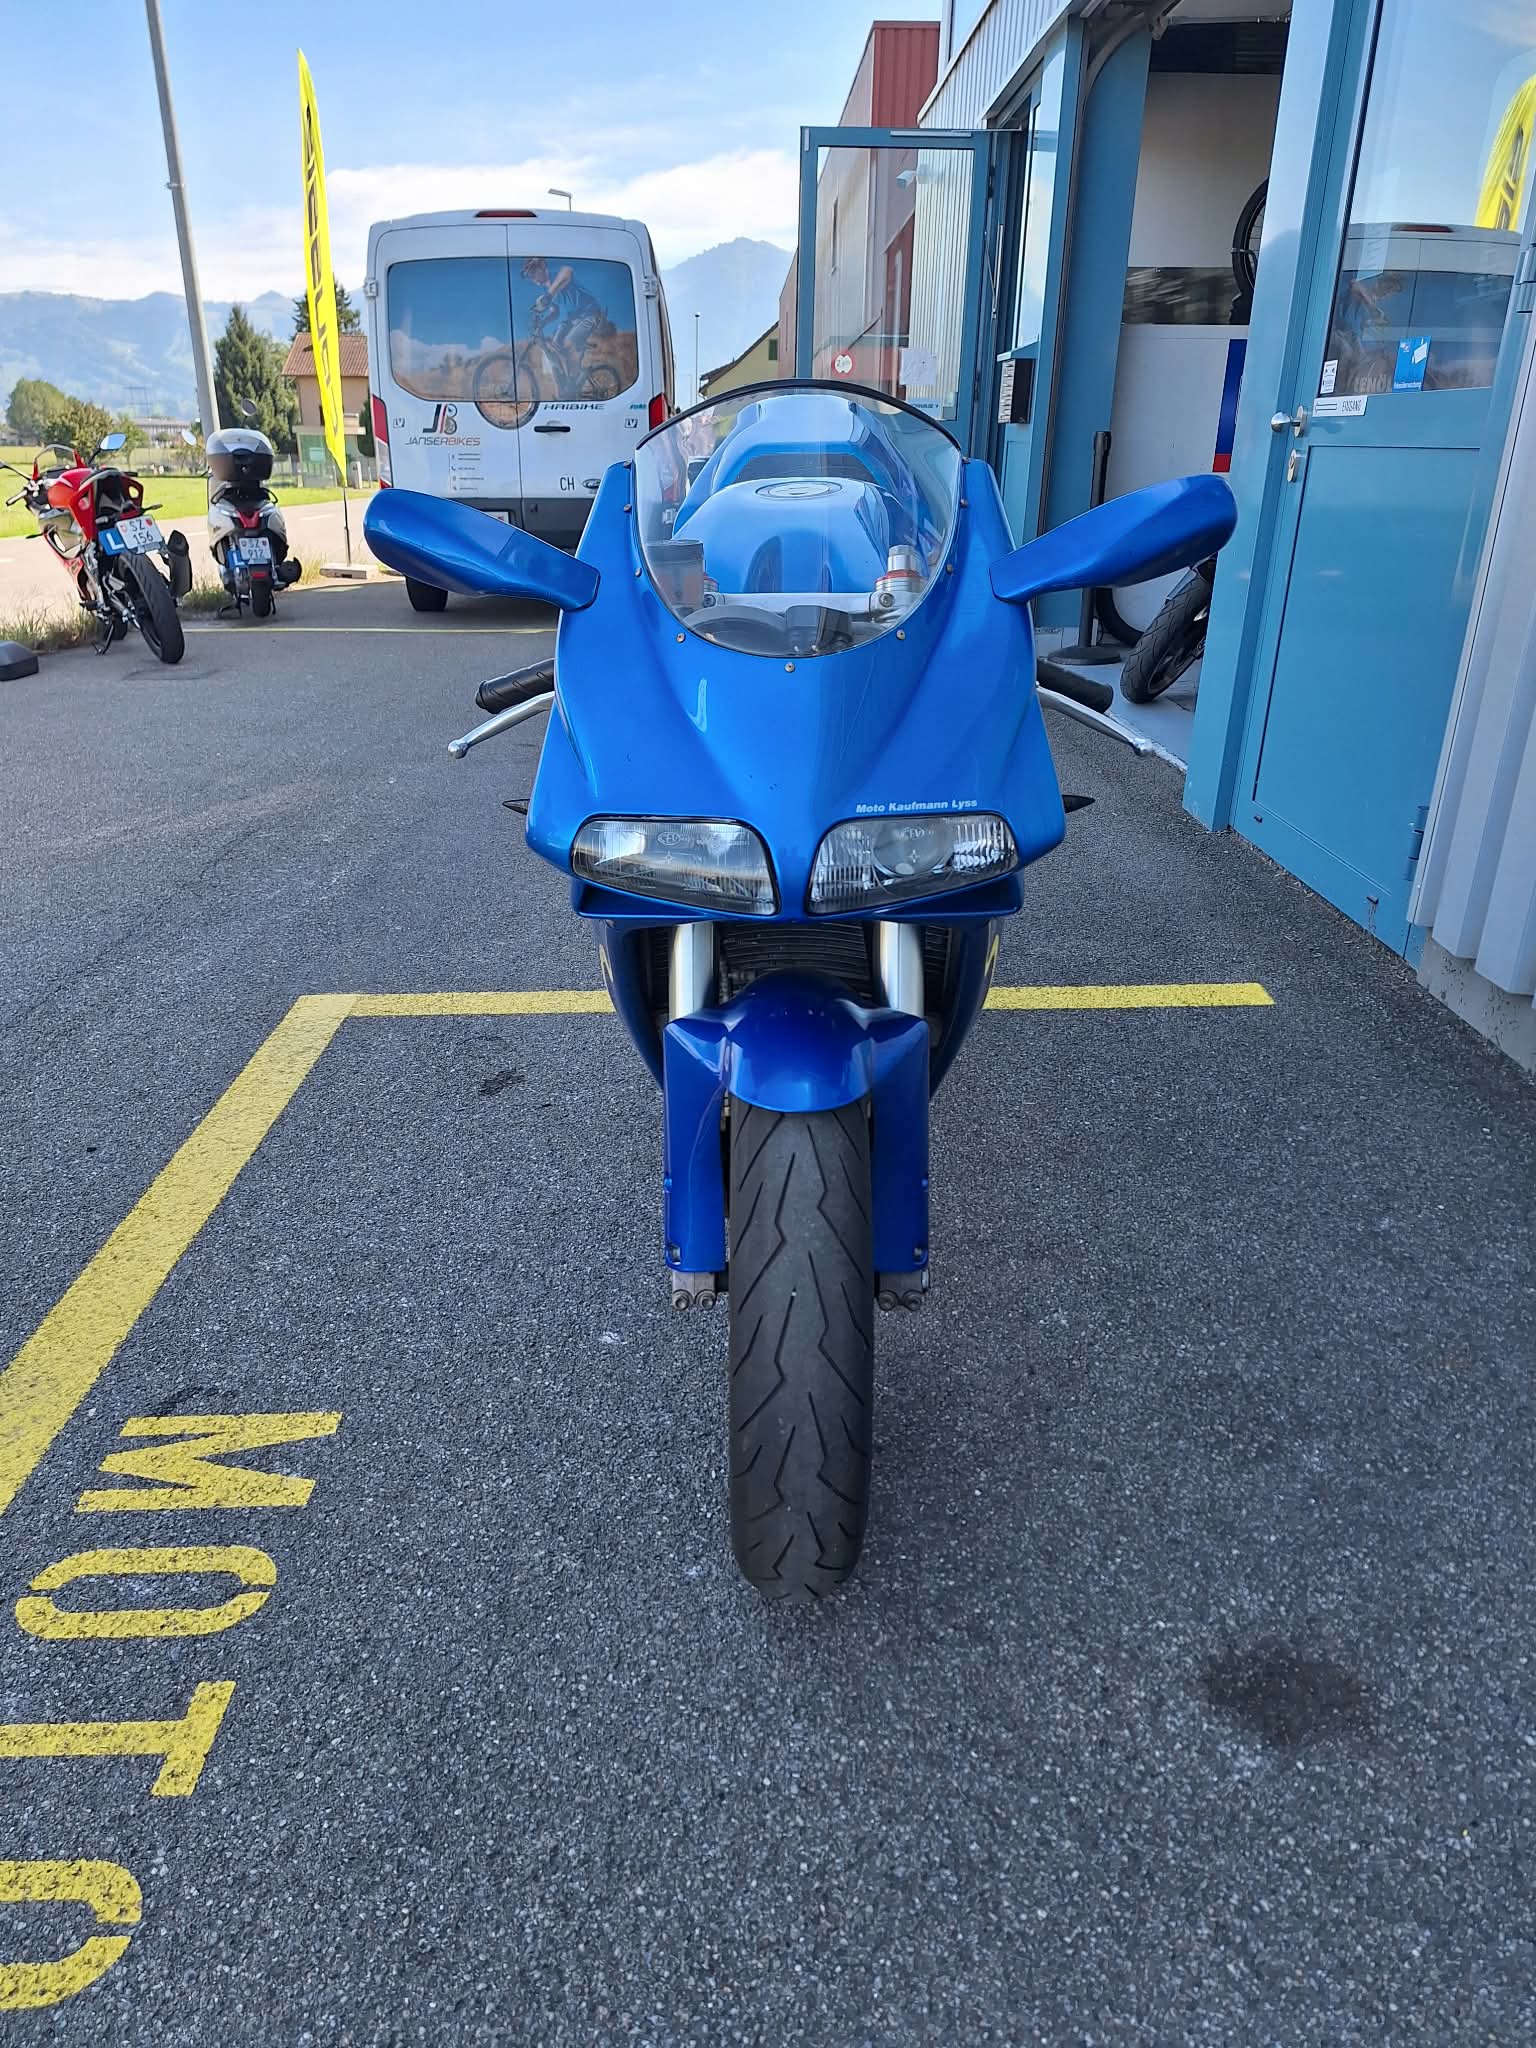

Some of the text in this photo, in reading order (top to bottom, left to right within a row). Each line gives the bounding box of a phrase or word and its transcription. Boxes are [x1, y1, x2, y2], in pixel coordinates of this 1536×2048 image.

[404, 437, 480, 446] JANSERBIKES
[559, 476, 575, 491] CH
[129, 518, 146, 532] SZ
[106, 532, 125, 550] L
[232, 551, 246, 566] L
[856, 799, 978, 813] Moto Kaufmann Lyss
